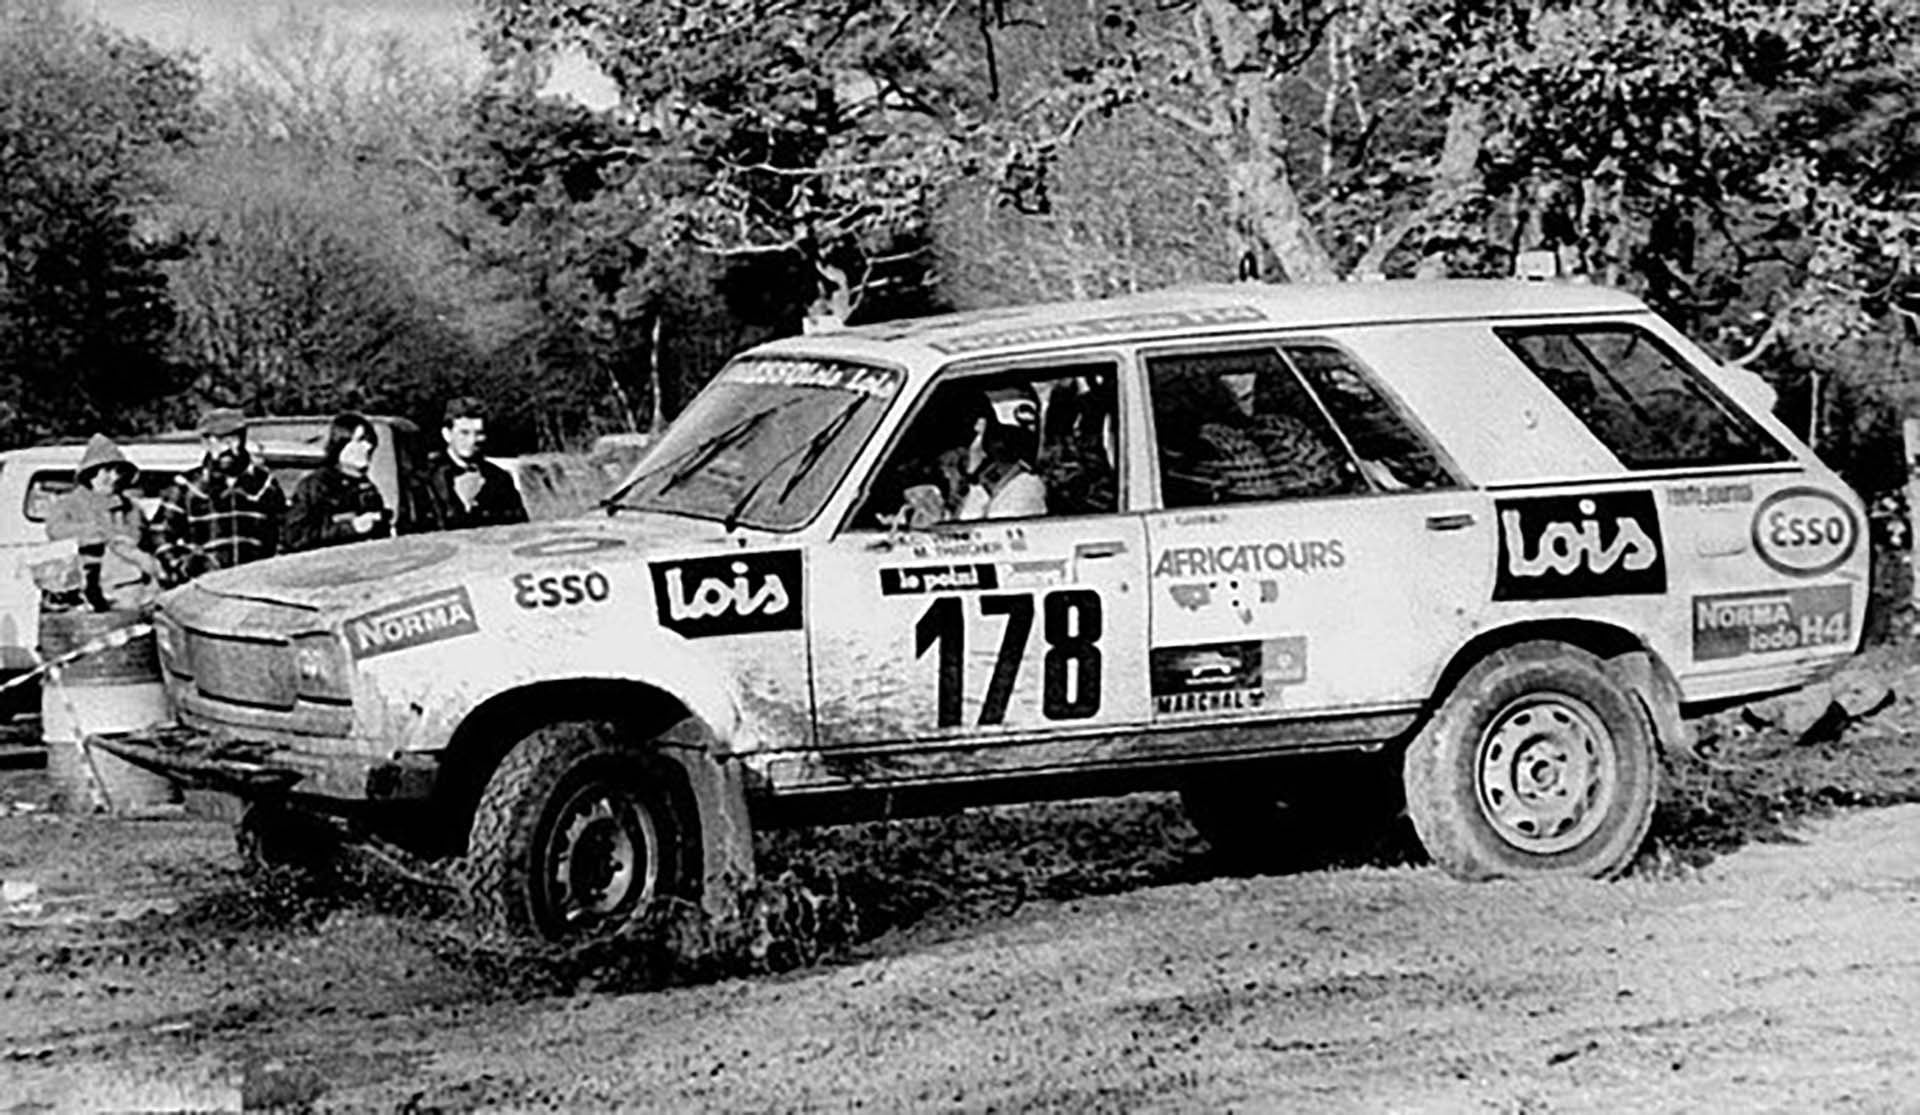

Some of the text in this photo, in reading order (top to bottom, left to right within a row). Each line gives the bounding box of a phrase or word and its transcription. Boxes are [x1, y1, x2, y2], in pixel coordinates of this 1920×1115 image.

[1154, 539, 1345, 577] AFRICATOURS
[1502, 498, 1658, 577] Lois
[665, 561, 789, 621] Lois
[356, 604, 471, 649] NORMA
[1698, 602, 1792, 630] NORMA
[1801, 612, 1847, 645] H4
[915, 589, 1103, 727] 178
